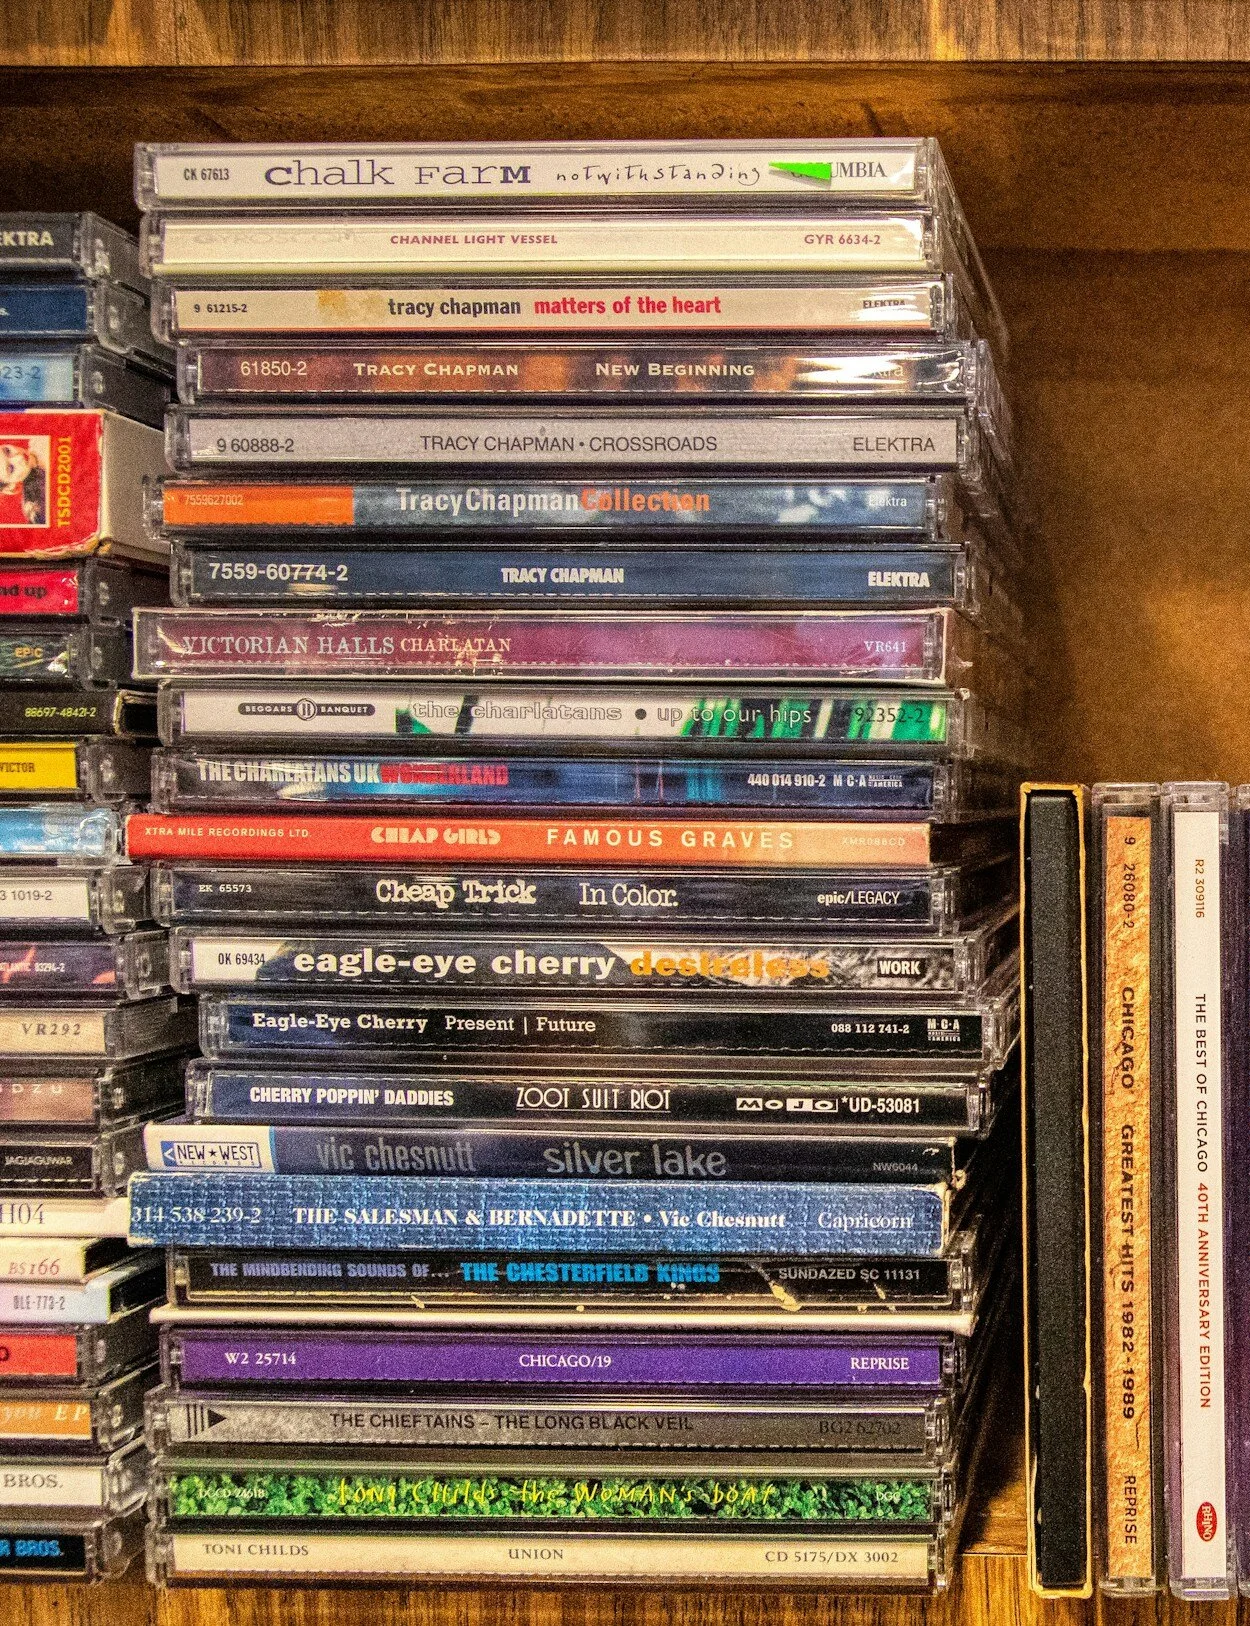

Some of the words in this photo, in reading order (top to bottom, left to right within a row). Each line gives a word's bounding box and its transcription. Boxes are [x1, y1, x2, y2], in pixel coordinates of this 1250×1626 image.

[200, 168, 229, 181] 67613
[390, 235, 459, 245] CHANNEL
[464, 235, 506, 244] LIGHT
[511, 235, 558, 244] VESSEL
[388, 299, 435, 318] tracy
[440, 298, 522, 319] chapman
[534, 297, 606, 314] matters
[673, 296, 721, 314] heart
[240, 360, 308, 377] 61850-2
[231, 439, 294, 453] 60888-2
[420, 435, 479, 452] TRACY
[484, 437, 575, 451] CHAPMAN
[590, 436, 717, 452] CROSSROADS
[853, 436, 935, 452] ELEKTRA
[58, 436, 71, 528] TSDCD2001
[184, 495, 243, 506] 7559627002
[209, 563, 348, 581] 7559-60774-2
[501, 567, 548, 583] TRACY
[551, 568, 624, 583] CHAPMAN
[868, 572, 930, 588] ELEKTRA
[25, 585, 46, 600] up
[15, 648, 42, 658] EPIC
[317, 637, 394, 655] HALLS
[400, 638, 511, 651] CHARLATAN
[245, 705, 292, 714] BEGGARS
[321, 705, 370, 714] BANQUET
[354, 764, 379, 783] UK
[208, 828, 284, 837] RECORDINGS
[548, 829, 663, 847] FAMOUS
[681, 831, 794, 849] GRAVES
[12, 891, 52, 902] 1019-2
[462, 880, 536, 904] Trick
[294, 947, 476, 978] eagle-eye
[492, 949, 616, 979] cherry
[21, 1024, 82, 1036] VR292
[252, 1013, 350, 1030] Eagle-Eye
[358, 1015, 428, 1033] Cherry
[445, 1016, 514, 1031] Present
[536, 1017, 596, 1031] Future
[1122, 987, 1134, 1088] CHICAGO
[250, 1087, 311, 1104] CHERRY
[384, 1088, 454, 1106] DADDIES
[1197, 1102, 1207, 1172] CHICAGO
[544, 1142, 641, 1174] silver
[653, 1145, 726, 1176] lake
[1121, 1125, 1133, 1234] GREATEST
[344, 1208, 458, 1225] SALESMAN
[490, 1209, 635, 1228] BERNADETTE
[697, 1211, 785, 1228] Chesnutt
[243, 1263, 342, 1277] MINDBENDING
[347, 1264, 406, 1277] SOUNDS
[779, 1268, 856, 1280] SUNDAZED
[1198, 1229, 1209, 1338] ANNIVERSARY
[519, 1353, 611, 1369] CHICAGO/19
[851, 1357, 909, 1370] REPRISE
[1200, 1345, 1210, 1409] EDITION
[381, 1413, 475, 1429] CHIEFTAINS
[534, 1415, 584, 1430] LONG
[589, 1415, 650, 1430] BLACK
[654, 1416, 693, 1431] VEIL
[4, 1474, 63, 1489] BROS.
[1124, 1475, 1137, 1545] REPRISE
[15, 1540, 64, 1556] BROS.
[203, 1544, 242, 1556] TONI
[248, 1544, 308, 1556] CHILDS
[508, 1549, 564, 1560] UNION
